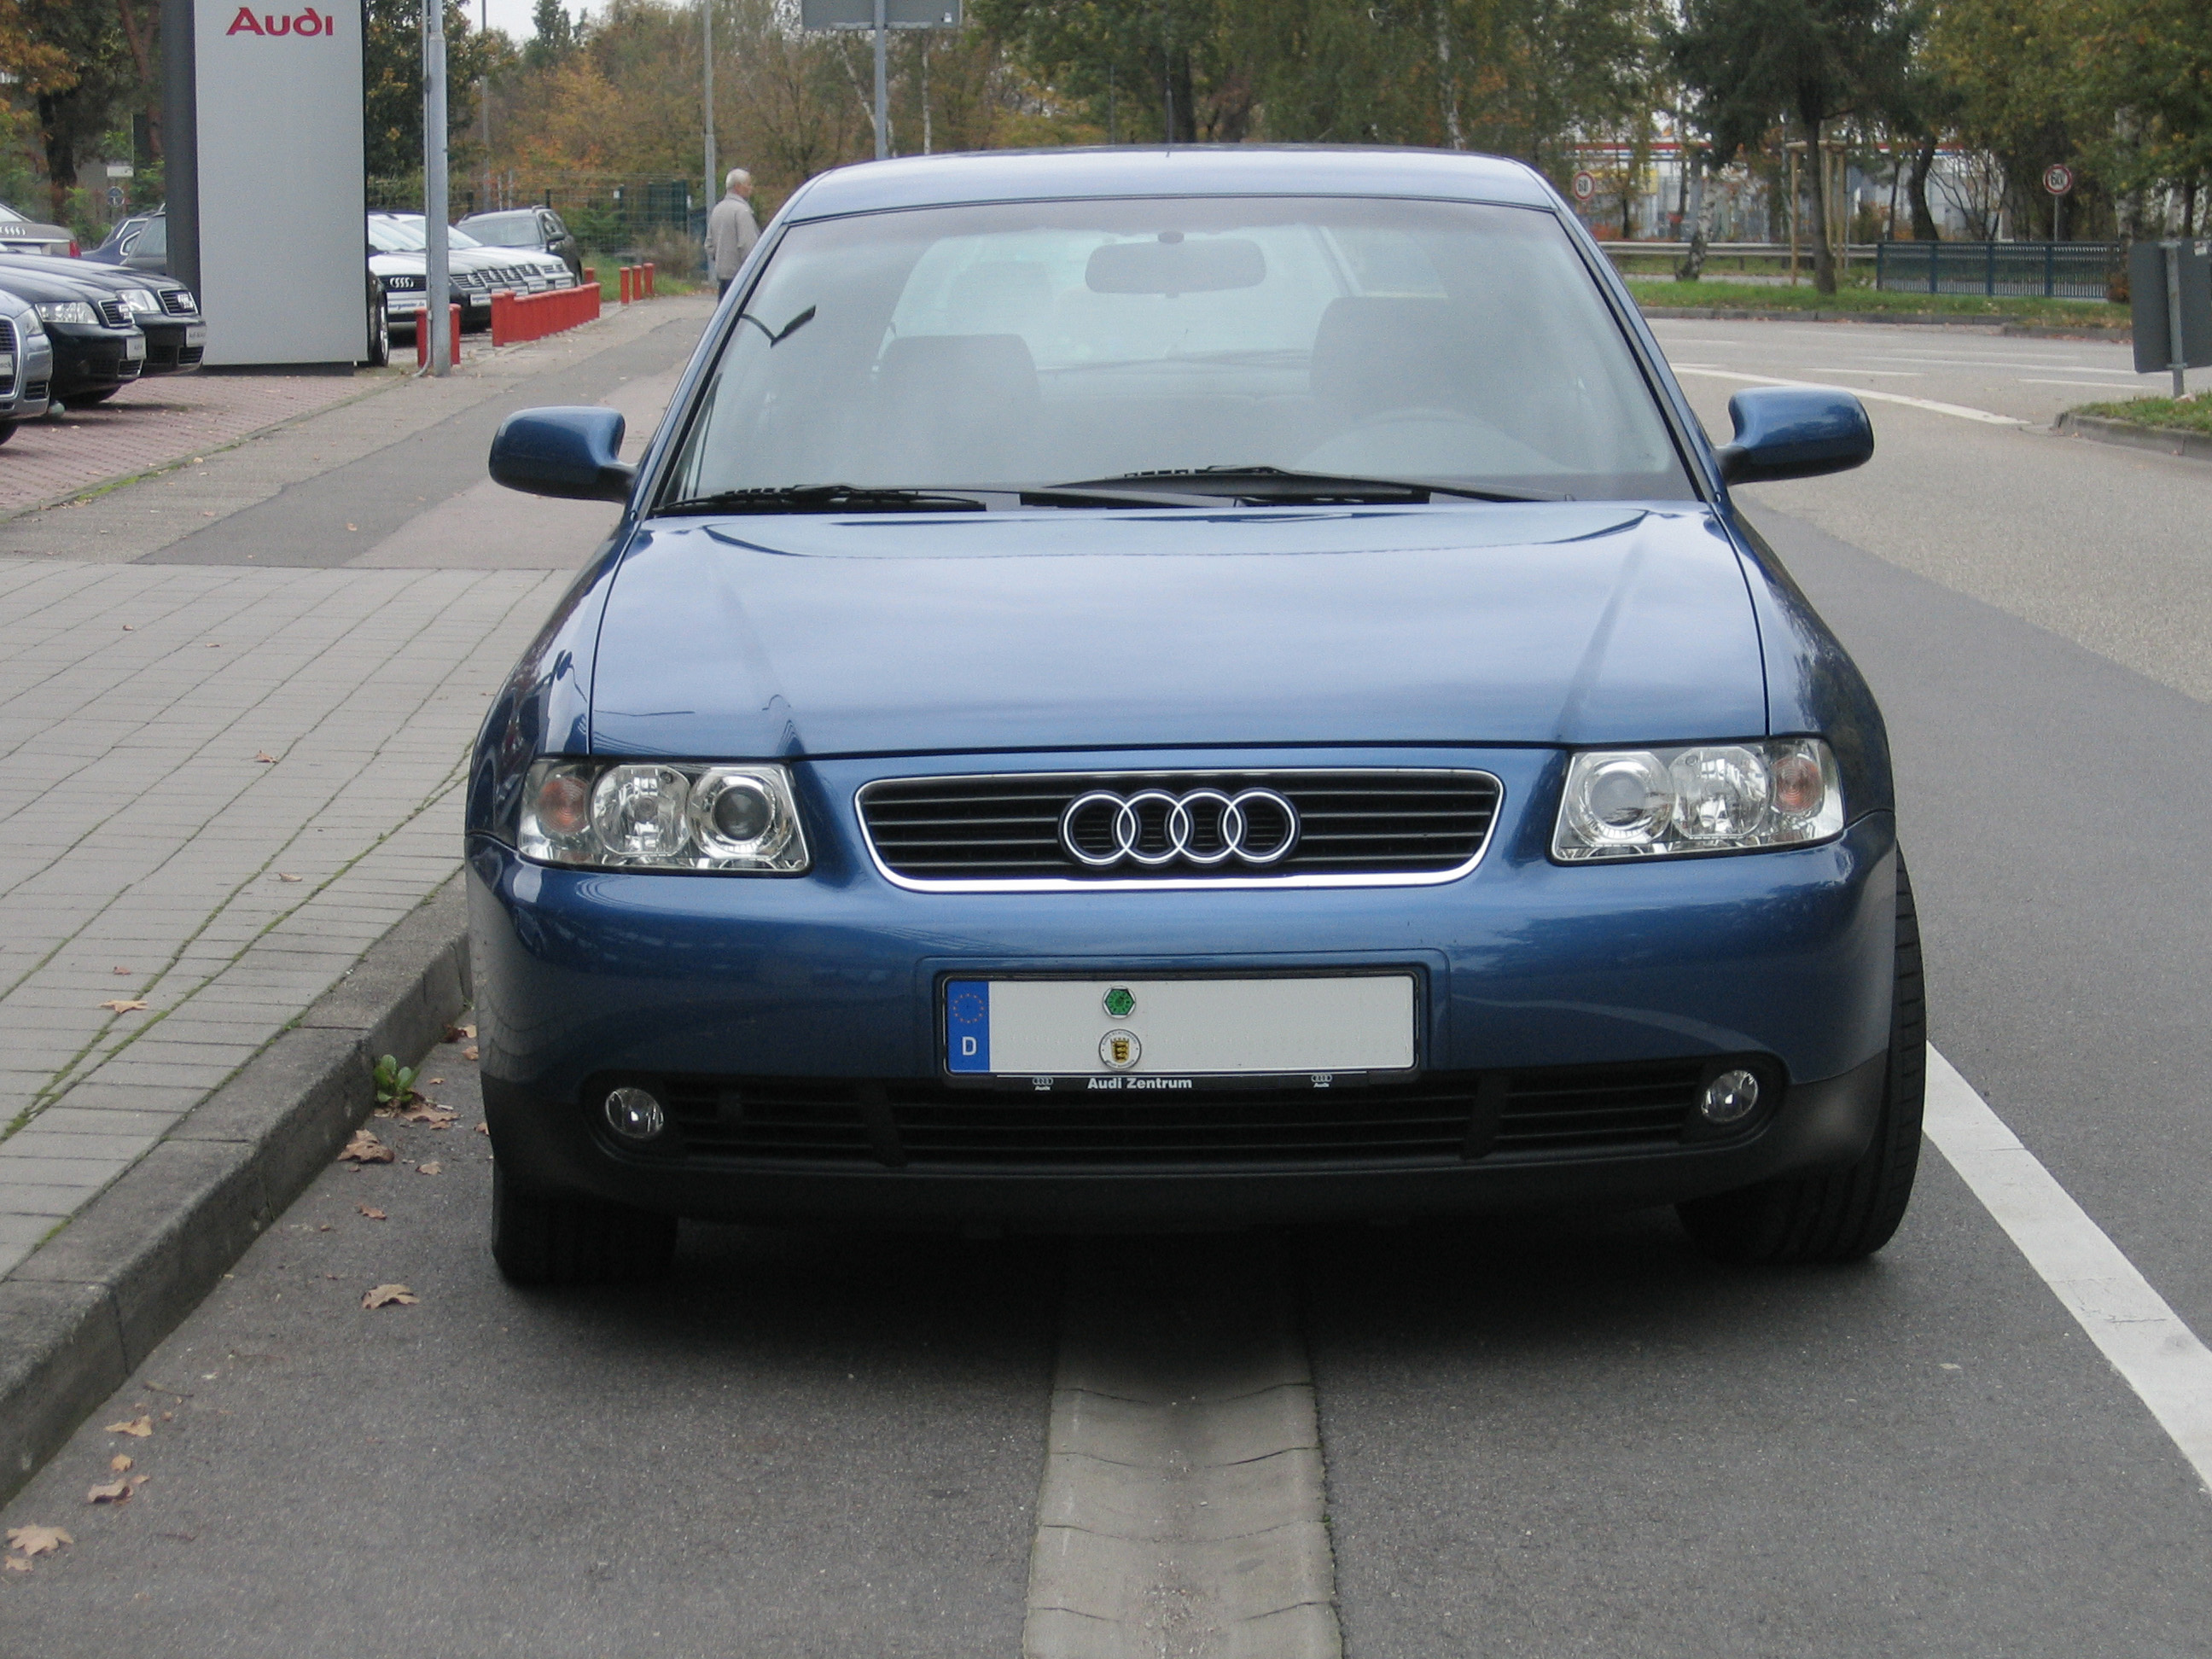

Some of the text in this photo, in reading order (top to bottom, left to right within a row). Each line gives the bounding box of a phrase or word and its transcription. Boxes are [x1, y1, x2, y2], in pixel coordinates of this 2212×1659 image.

[225, 7, 334, 37] Audi
[962, 1036, 977, 1056] D
[1087, 1077, 1193, 1090] Audi Zentrum
